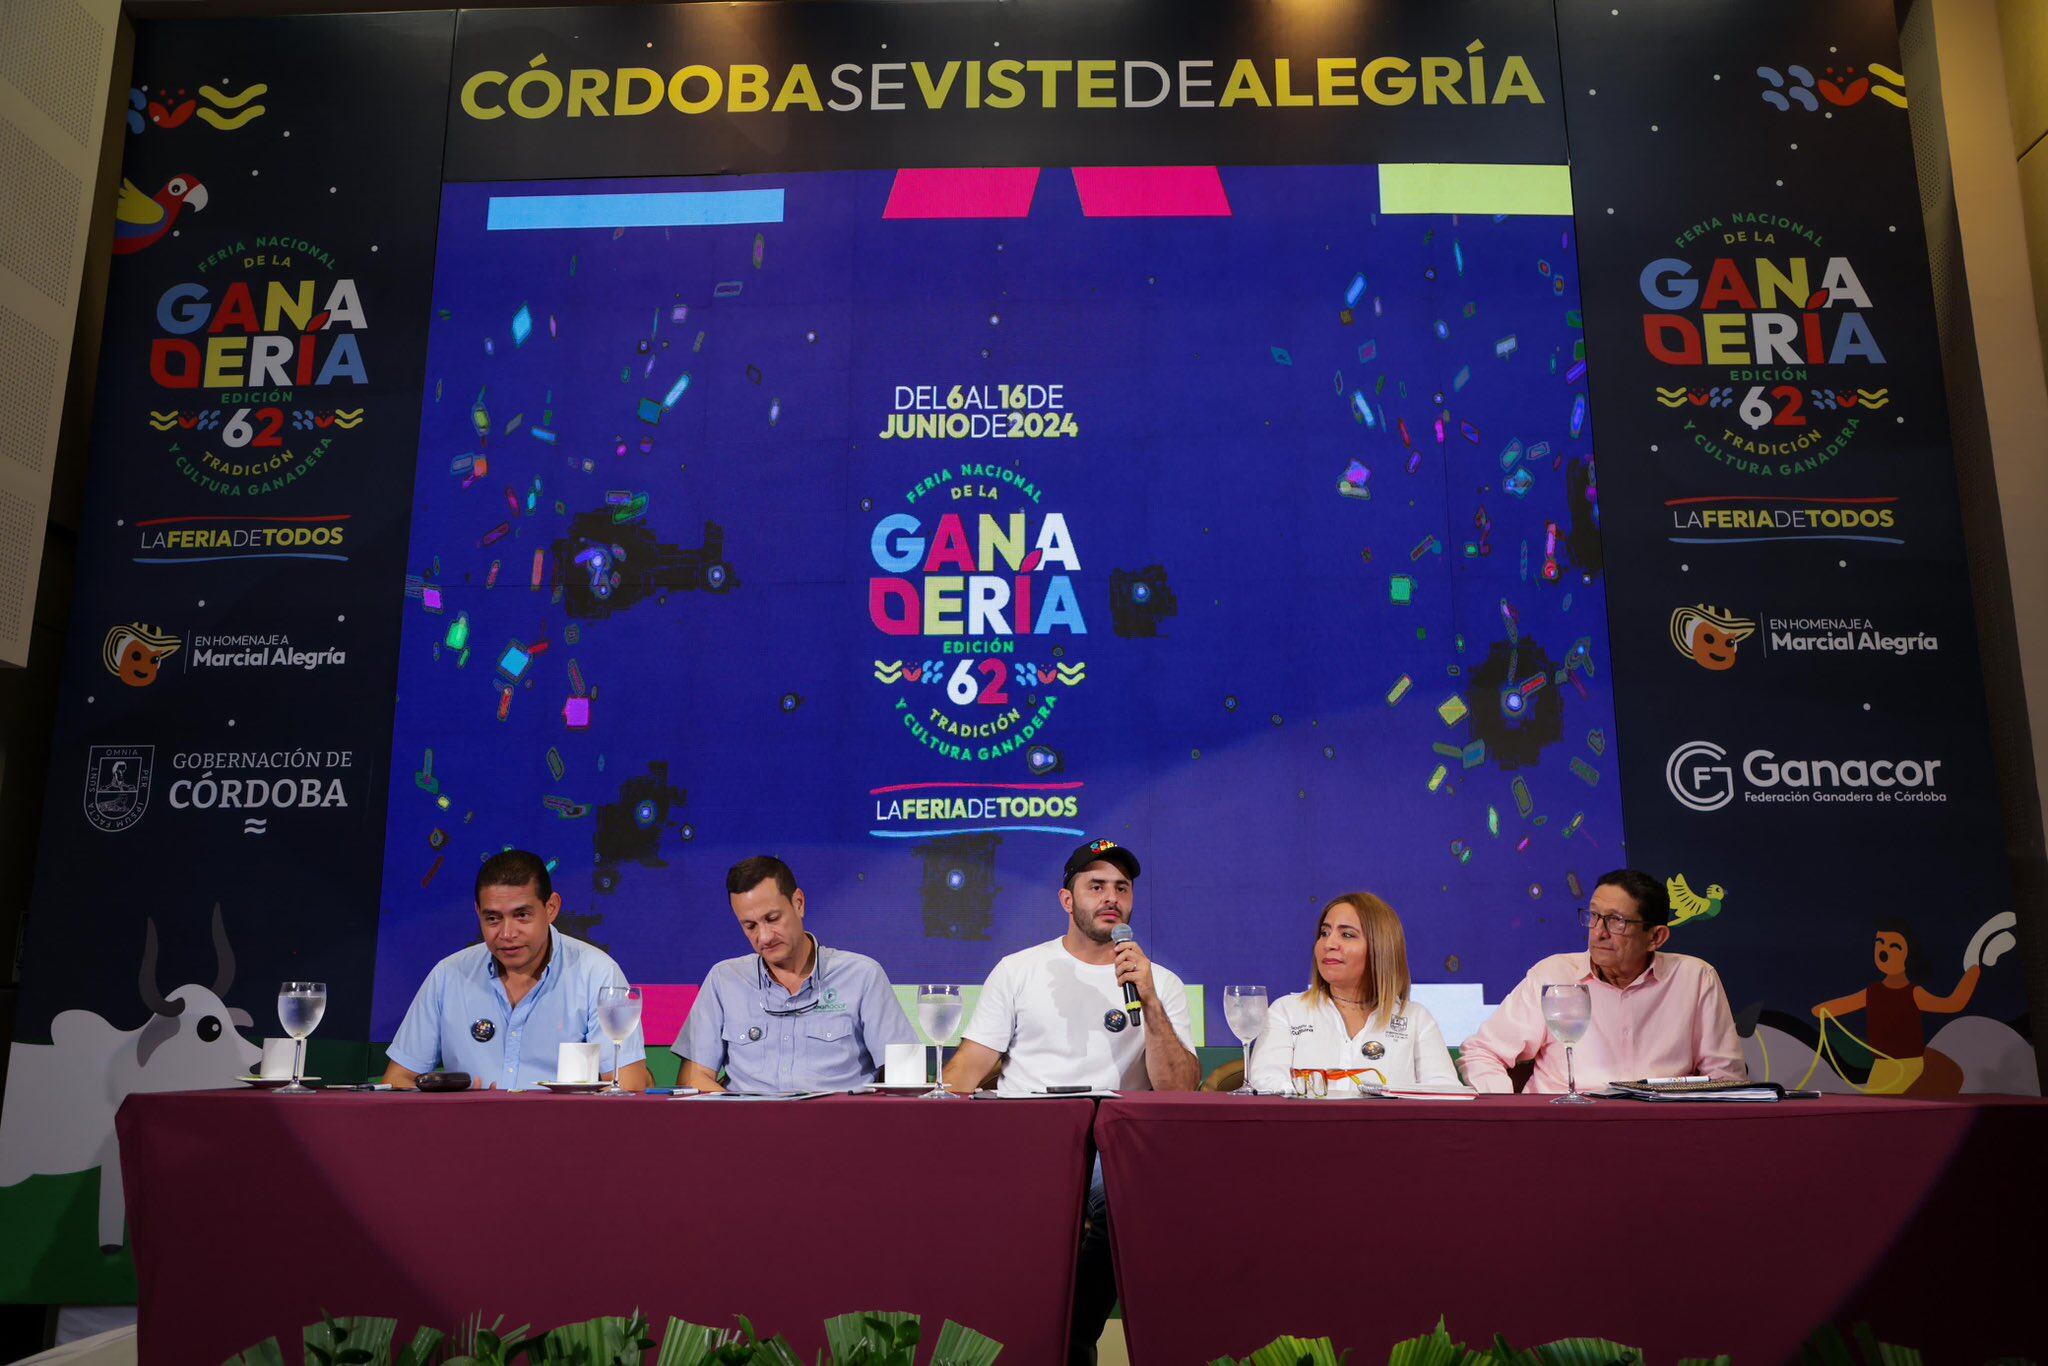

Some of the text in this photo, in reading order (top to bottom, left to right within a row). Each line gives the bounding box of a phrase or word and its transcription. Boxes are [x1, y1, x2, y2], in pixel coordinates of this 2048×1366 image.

[1674, 211, 1824, 249] FERIA NACIONAL
[1723, 231, 1776, 245] DE LA
[198, 236, 337, 272] FERIA NACIONAL
[243, 255, 292, 269] DE LA
[1730, 366, 1808, 382] EDICIÓN
[220, 388, 294, 404] EDICIÓN
[1739, 385, 1807, 427] 62
[222, 407, 285, 448] 62
[1683, 416, 1861, 477] Y CULTURA GANADERA
[1722, 429, 1823, 456] TRADICIÓN
[168, 436, 334, 497] Y CULTURA GANADERA
[201, 449, 295, 477] TRADICIÓN
[906, 463, 1042, 504] FERIA NACIONAL
[950, 484, 999, 500] DE LA
[1770, 618, 1788, 630] EN
[1789, 618, 1862, 630] HOMENAJE
[195, 635, 211, 647] EN
[213, 634, 280, 647] HOMENAJE
[943, 637, 1015, 654] EDICIÓN
[1771, 631, 1939, 656] Marcial Alegría
[193, 646, 346, 670] Marcial Alegría
[946, 658, 1009, 706] 62
[903, 713, 973, 762] CULTURA
[978, 695, 1058, 762] GANADERA
[930, 707, 1022, 738] TRADICIÓN
[173, 748, 353, 769] GOBERNACIÓN DE
[1742, 749, 1942, 788] Ganacor
[88, 767, 99, 793] SUNT
[168, 770, 349, 810] CÓRDOBA
[1744, 790, 1947, 803] Federación Ganadera de Córdoba
